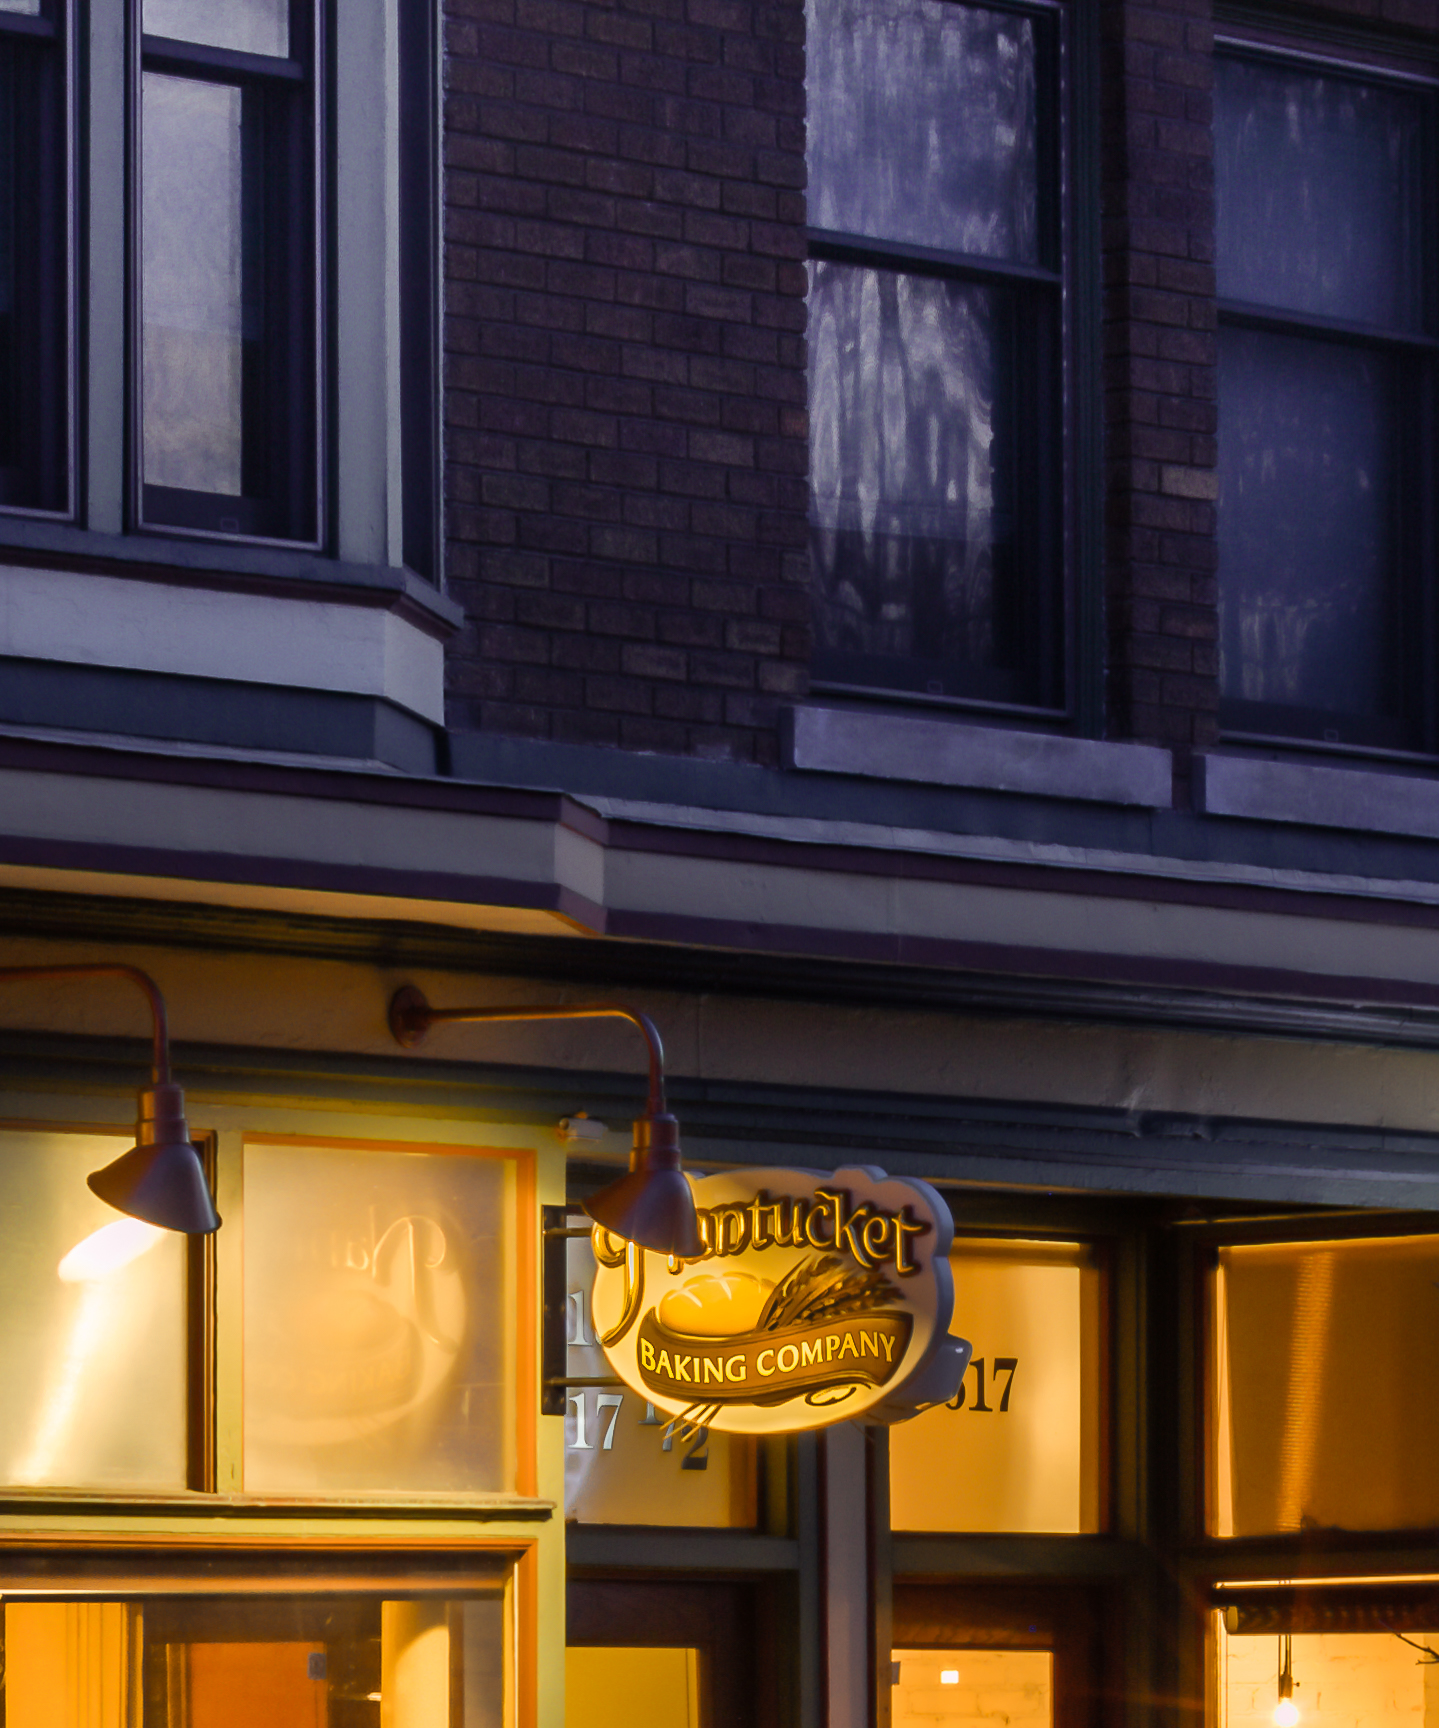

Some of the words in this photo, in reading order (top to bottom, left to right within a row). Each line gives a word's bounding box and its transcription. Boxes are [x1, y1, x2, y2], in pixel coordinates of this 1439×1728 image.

[592, 1187, 927, 1348] ntucket
[640, 1337, 747, 1385] BAKING
[756, 1329, 896, 1378] COMPANY
